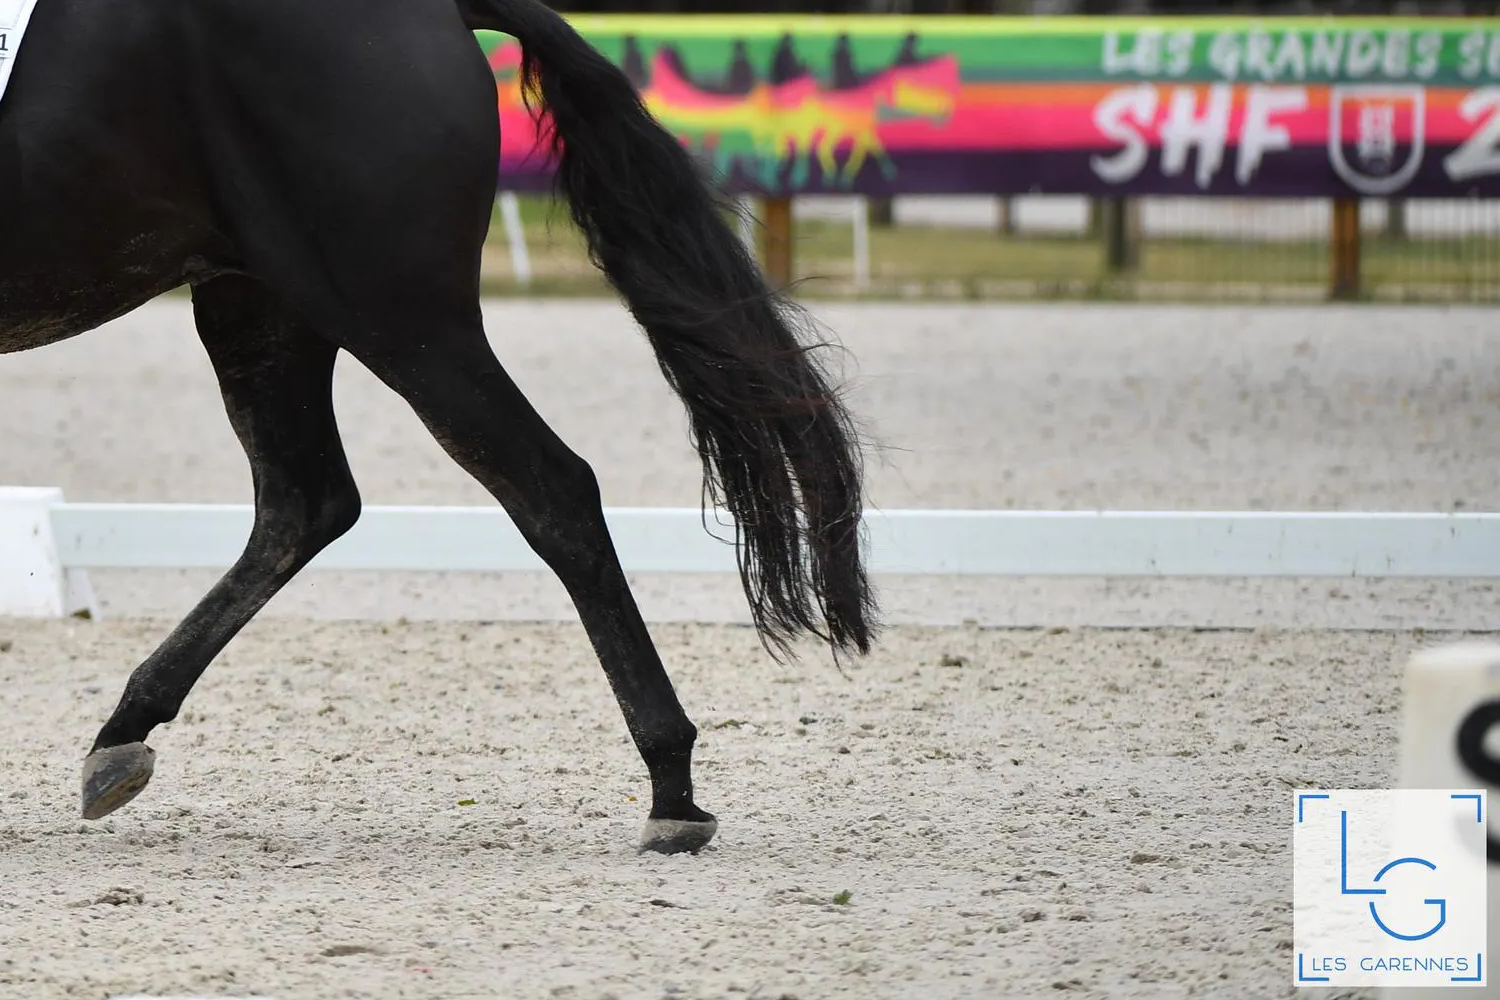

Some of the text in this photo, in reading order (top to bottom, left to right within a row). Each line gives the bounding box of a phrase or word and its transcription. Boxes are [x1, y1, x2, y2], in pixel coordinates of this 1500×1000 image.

[1102, 28, 1195, 77] LES
[1207, 26, 1443, 80] GRANDES
[1090, 81, 1308, 188] SHF
